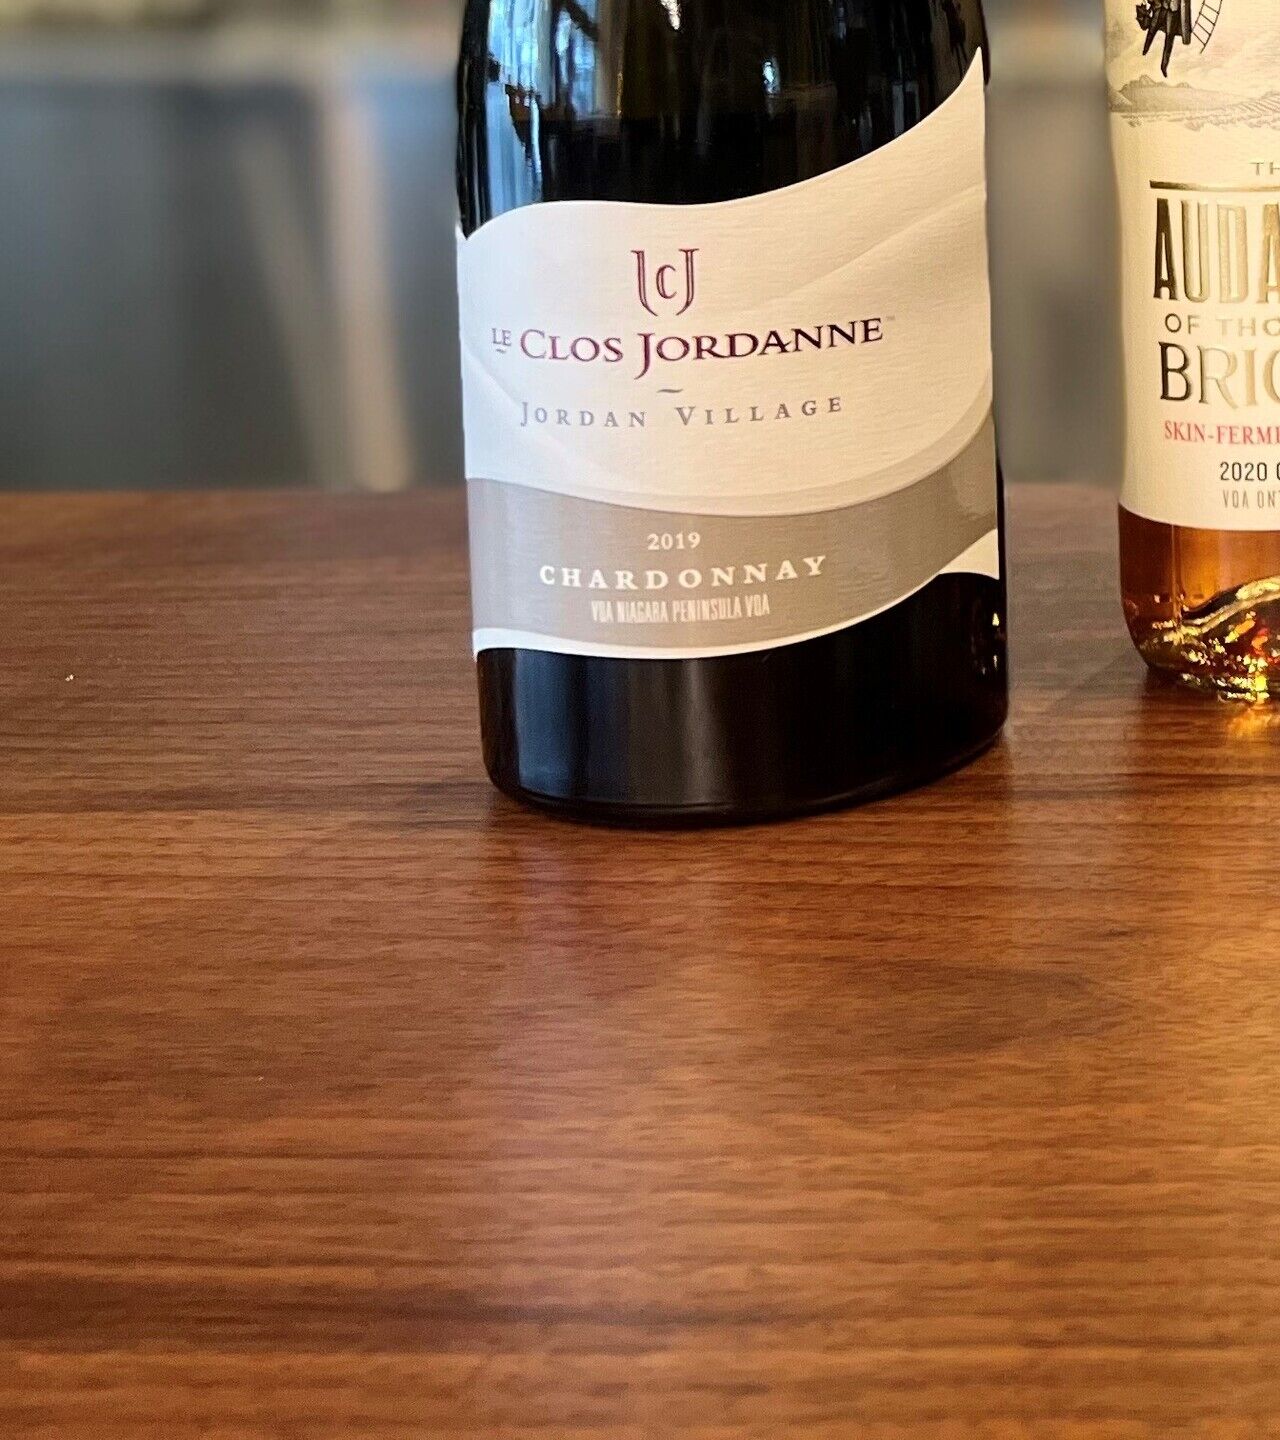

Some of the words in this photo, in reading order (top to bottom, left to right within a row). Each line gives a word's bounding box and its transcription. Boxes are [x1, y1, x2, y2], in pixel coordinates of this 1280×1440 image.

[1164, 312, 1201, 334] OF
[491, 326, 512, 347] LE
[520, 329, 623, 362] CLOS
[634, 316, 884, 380] JORDANNE
[520, 402, 647, 428] JORDAN
[675, 396, 842, 426] VILLAGE
[1220, 461, 1268, 482] 2020
[1222, 488, 1250, 509] VQA
[647, 532, 701, 551] 2019
[539, 556, 827, 590] CHARDONNAY
[617, 600, 669, 624] NIAGARA
[672, 596, 742, 622] PENINSULA
[745, 593, 770, 617] VQA
